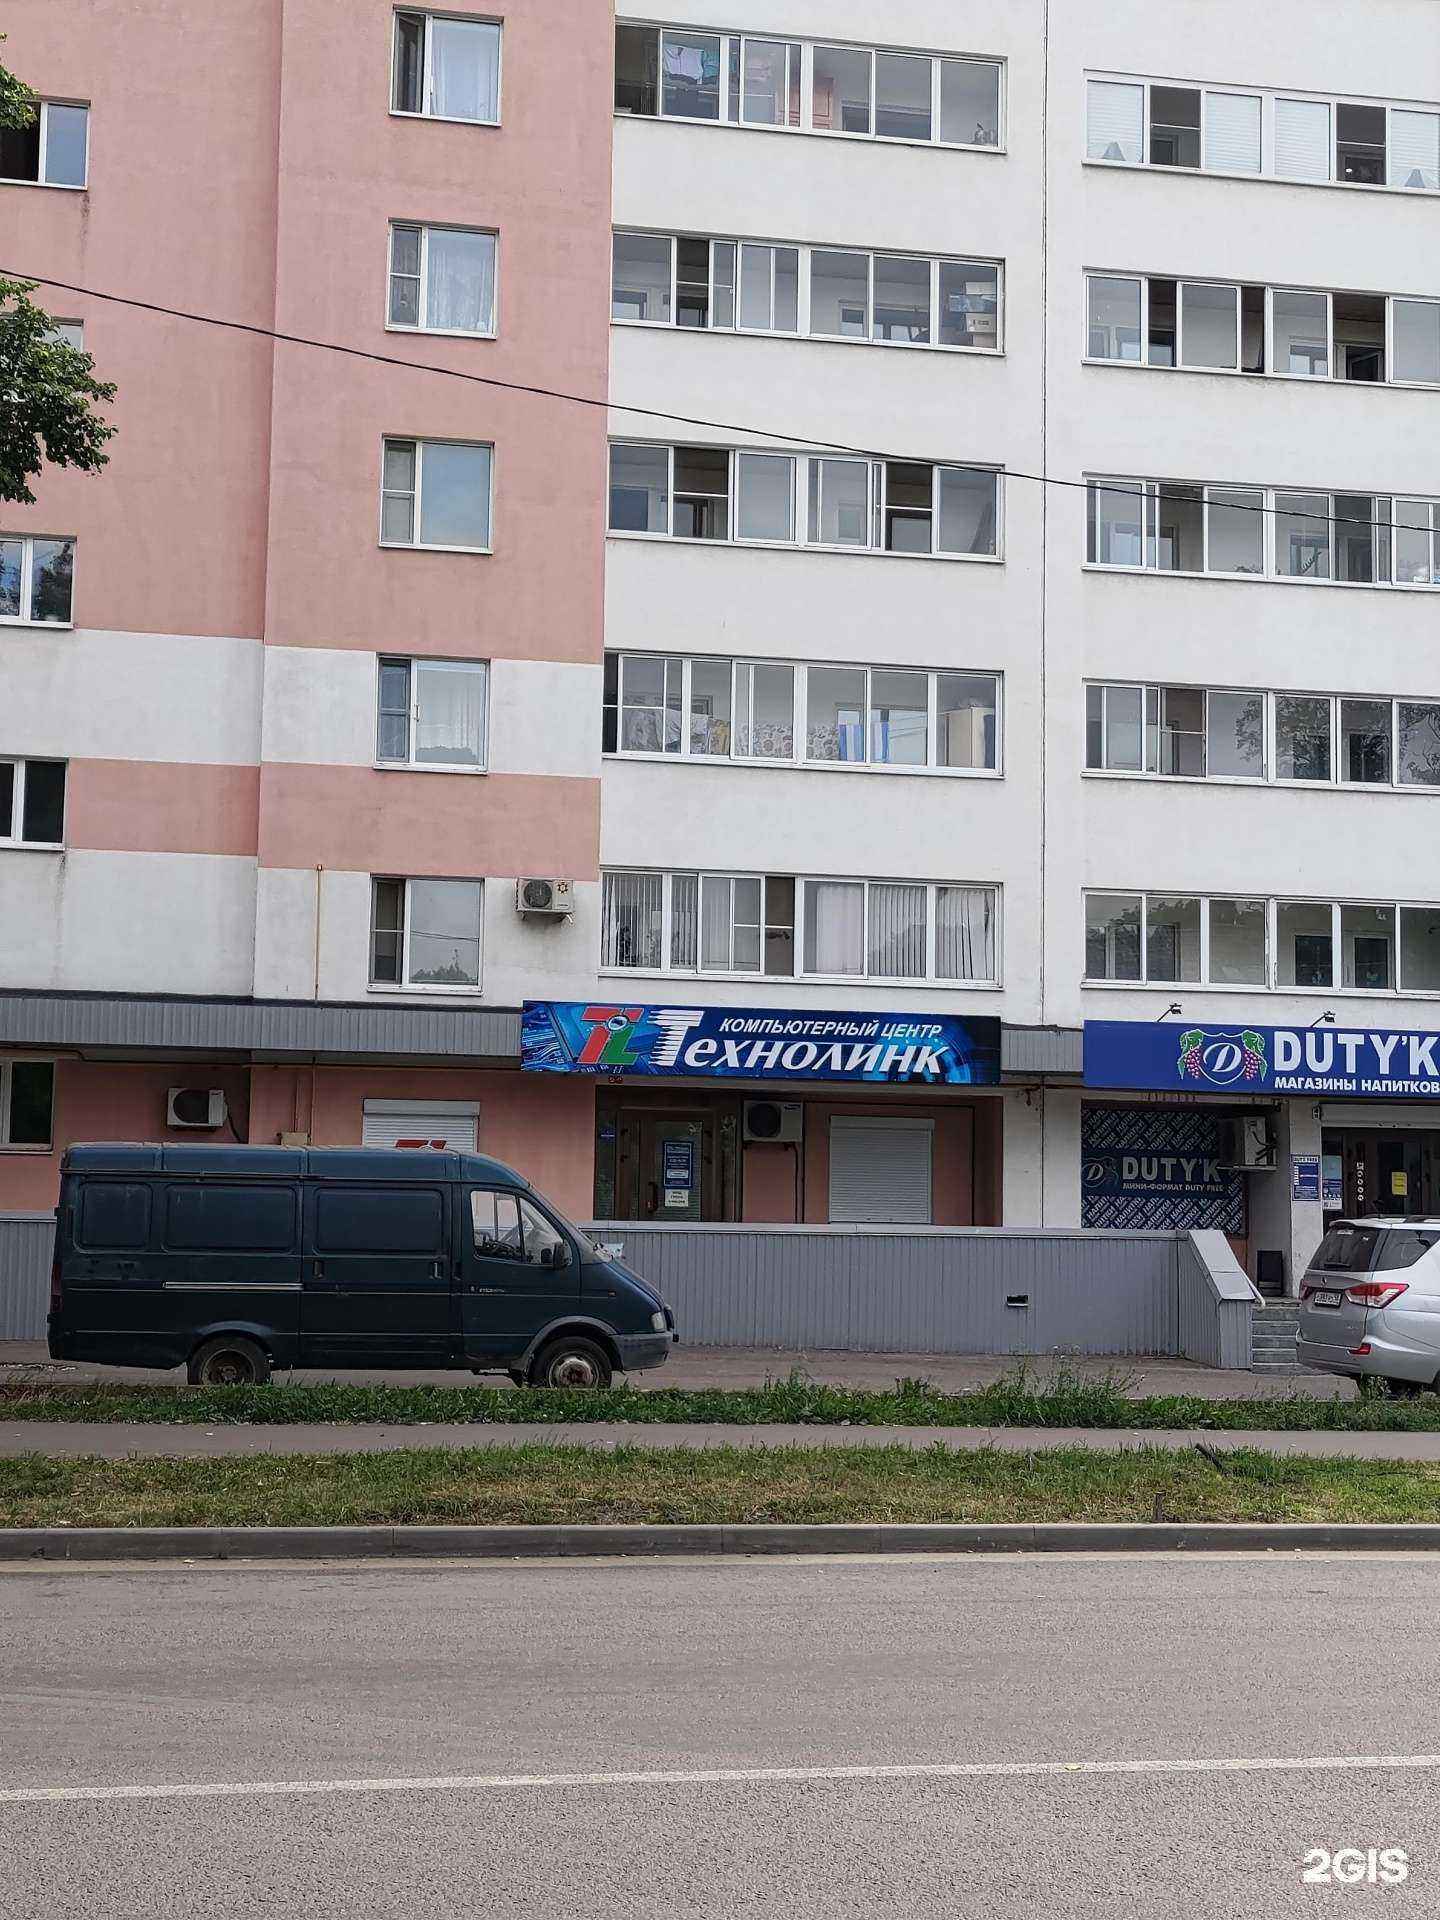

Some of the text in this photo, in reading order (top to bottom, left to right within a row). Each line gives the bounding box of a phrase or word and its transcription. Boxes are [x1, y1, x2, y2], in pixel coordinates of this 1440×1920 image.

[719, 1018, 944, 1040] КОМПЬЮТЕРНЫЙ ЦЕНТР
[1274, 1076, 1440, 1094] МАГАЗИНЫ НАПИТКОВ
[1122, 1156, 1222, 1183] DUTY'K
[1122, 1182, 1183, 1192] МИНИ-ФОРМАТ
[1186, 1184, 1205, 1192] DUTY
